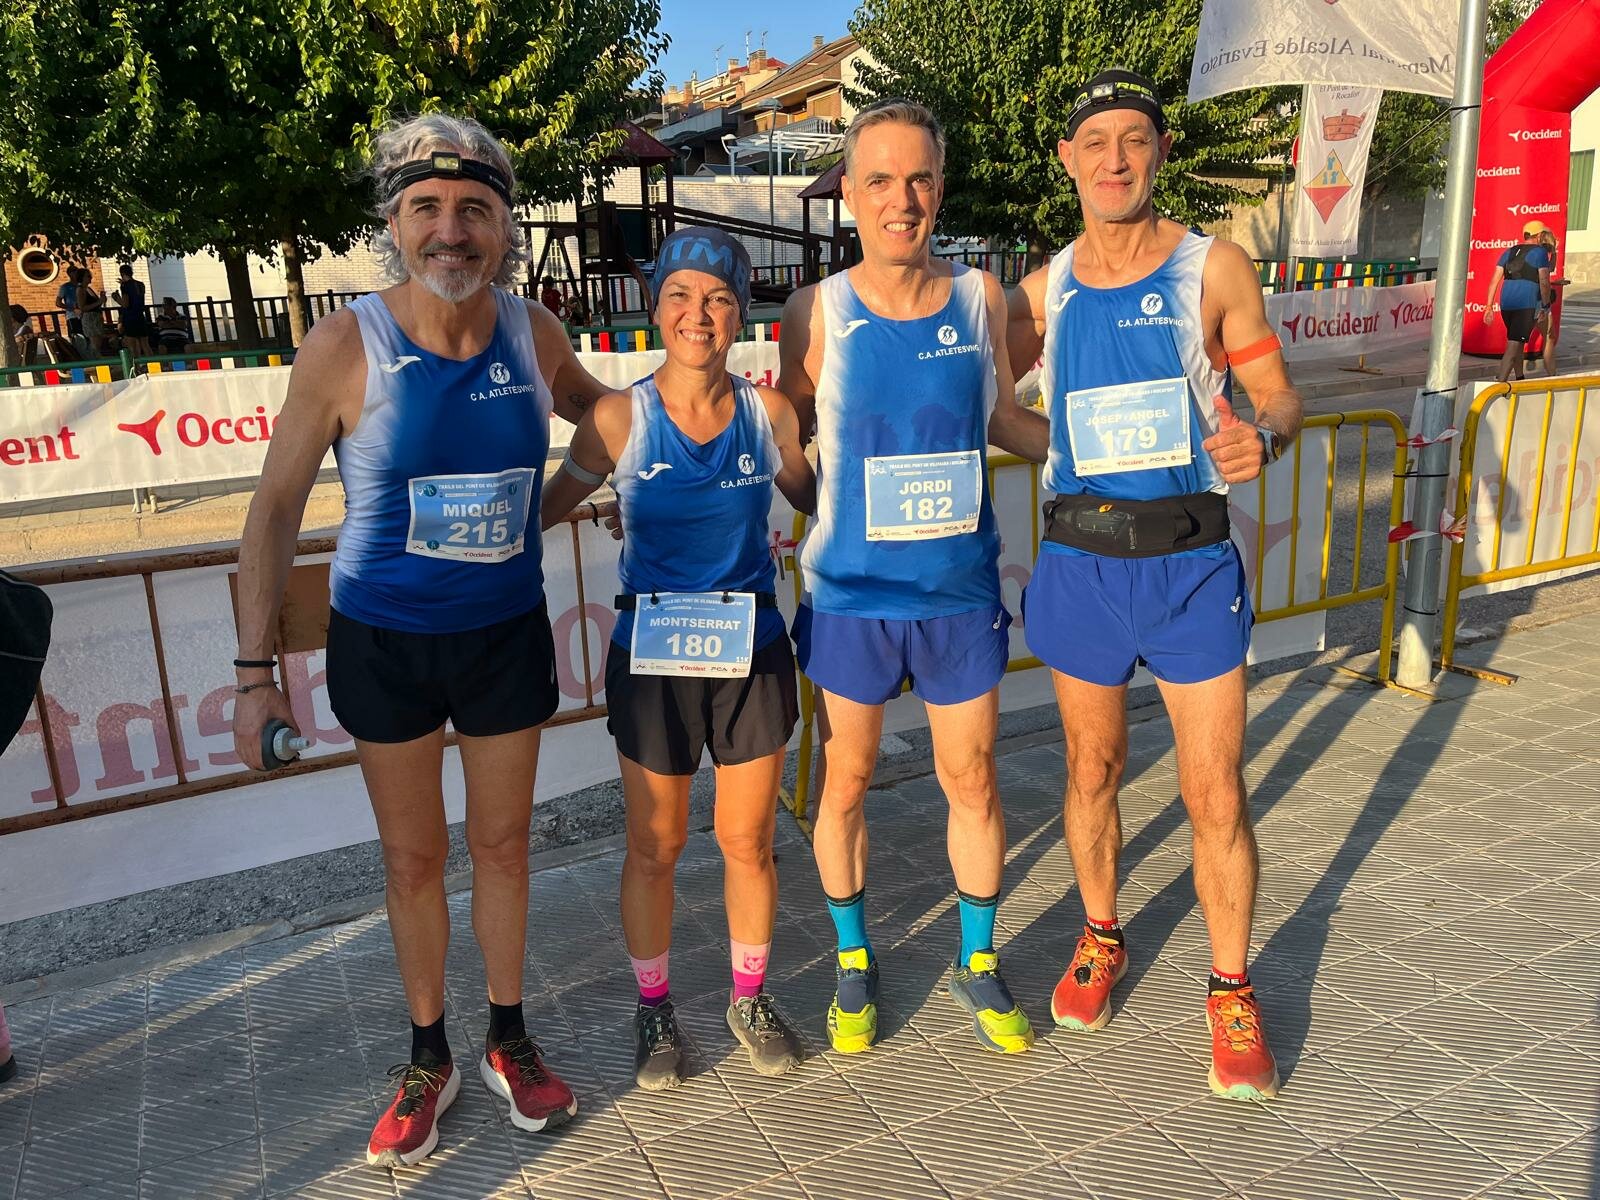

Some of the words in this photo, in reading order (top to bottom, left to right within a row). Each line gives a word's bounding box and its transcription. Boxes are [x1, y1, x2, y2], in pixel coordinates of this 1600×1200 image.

[1521, 128, 1562, 140] Occident
[1477, 166, 1521, 177] Occident
[1520, 203, 1560, 214] Occident
[1304, 311, 1380, 339] Occident
[176, 406, 279, 448] Occi
[1100, 426, 1158, 456] 179
[899, 479, 952, 495] JORDI
[443, 499, 512, 517] MIQUEL
[899, 496, 953, 521] 182
[447, 519, 508, 544] 215
[649, 617, 742, 631] MONTSERRAT
[666, 633, 722, 658] 180
